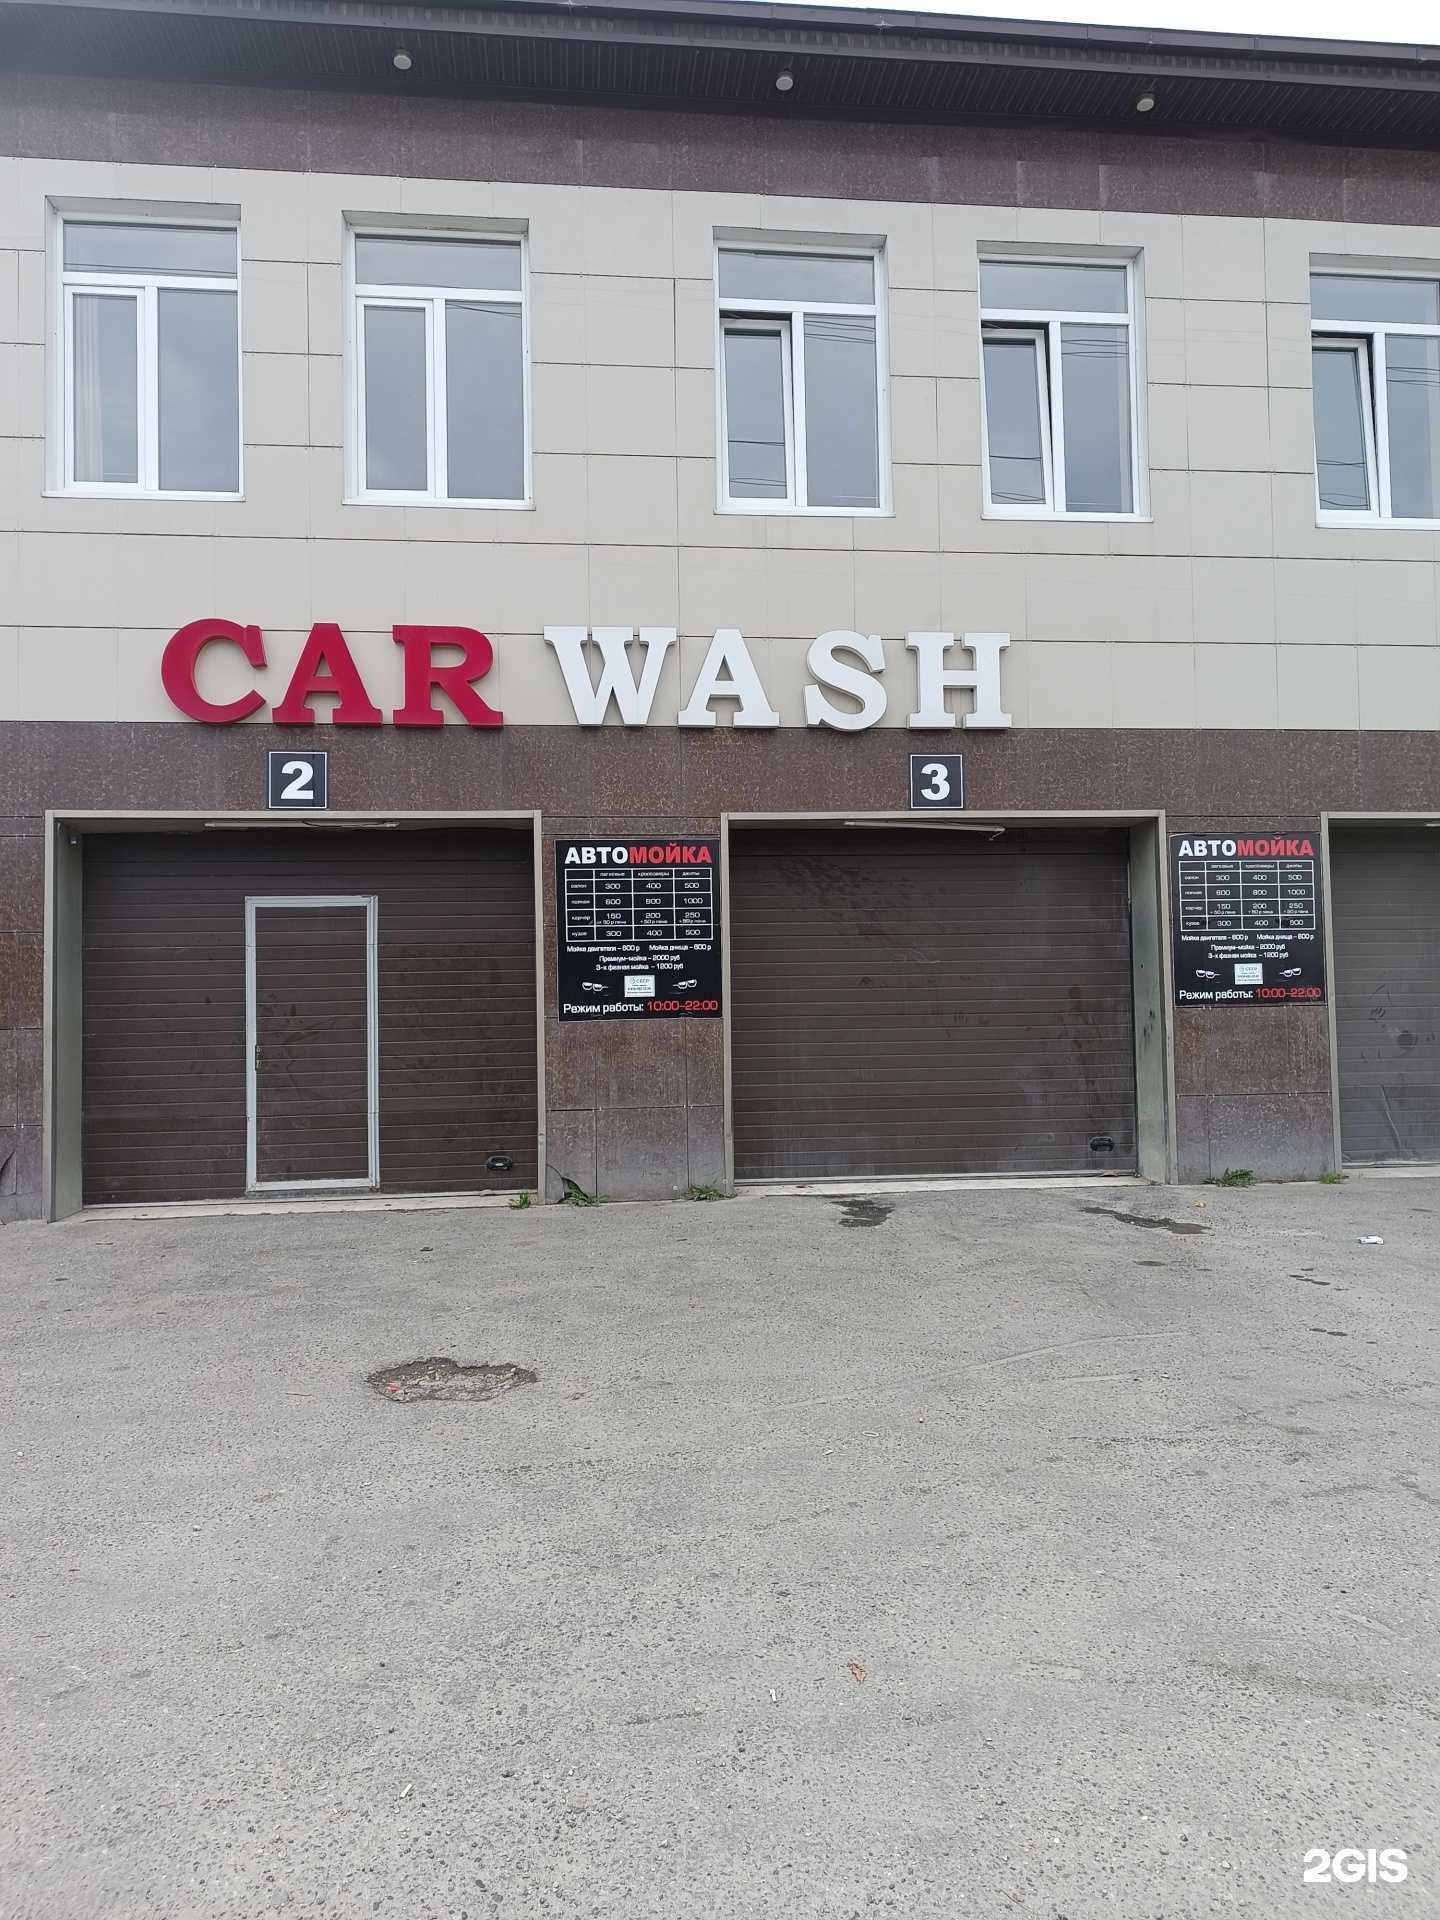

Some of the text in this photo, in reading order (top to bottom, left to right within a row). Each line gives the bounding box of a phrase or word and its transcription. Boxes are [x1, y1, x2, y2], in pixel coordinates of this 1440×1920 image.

[161, 618, 1013, 733] CAR WASH
[280, 761, 315, 800] 2
[920, 763, 951, 801] 3
[564, 843, 712, 864] АВТОМОЙКА
[1179, 835, 1313, 857] АВТОМОЙКА
[1179, 990, 1214, 1000] Режим
[1215, 989, 1253, 1001] работы:
[563, 1003, 601, 1013] Режим
[603, 1002, 644, 1015] работы:
